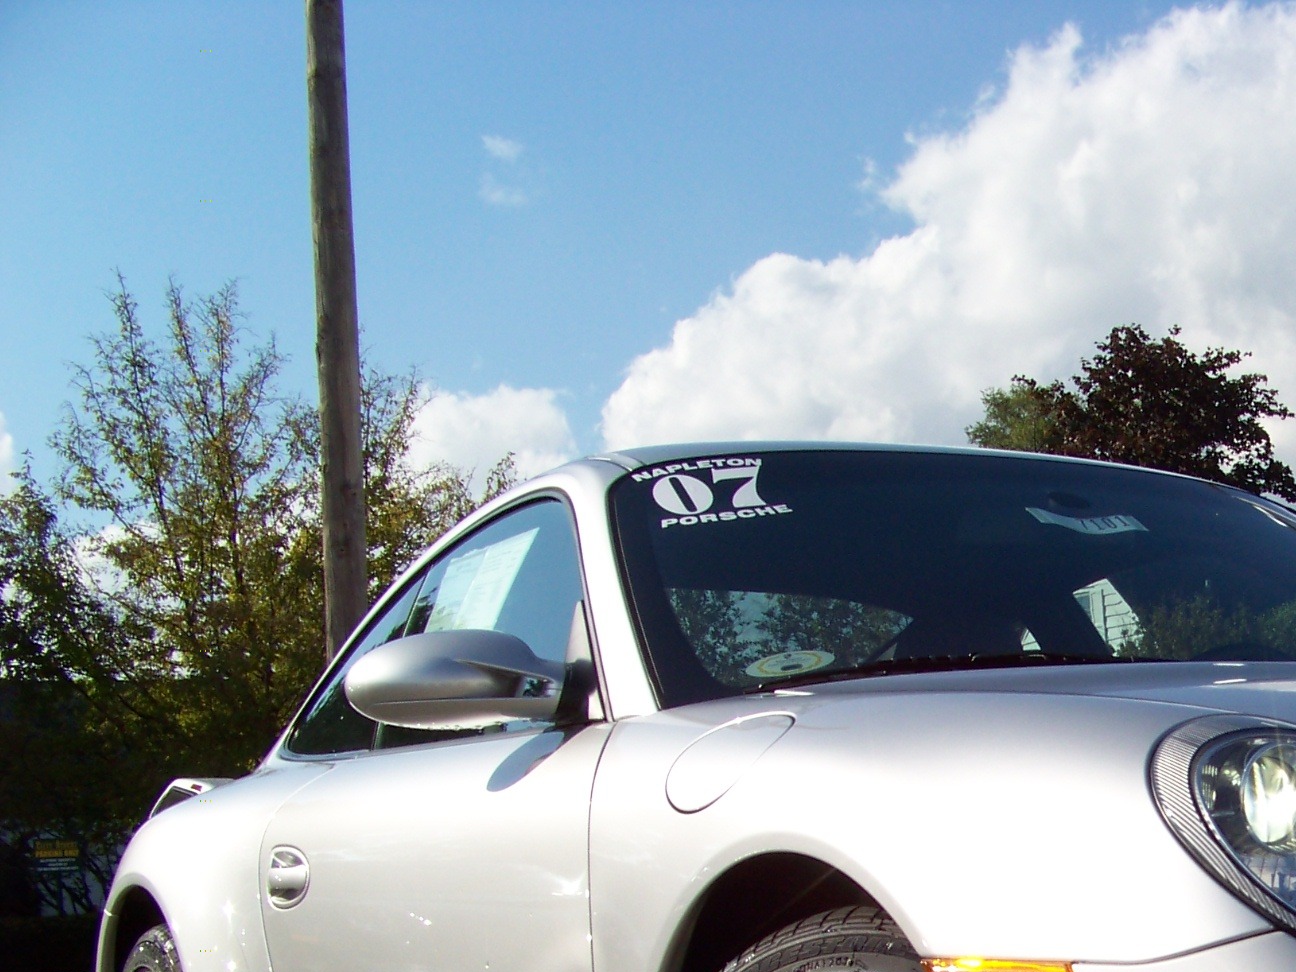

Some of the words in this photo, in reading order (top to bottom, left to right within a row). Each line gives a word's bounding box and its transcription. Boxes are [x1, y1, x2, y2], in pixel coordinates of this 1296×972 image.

[631, 458, 762, 482] NAPLETON
[652, 465, 767, 515] 07
[661, 504, 793, 528] PORSCHE
